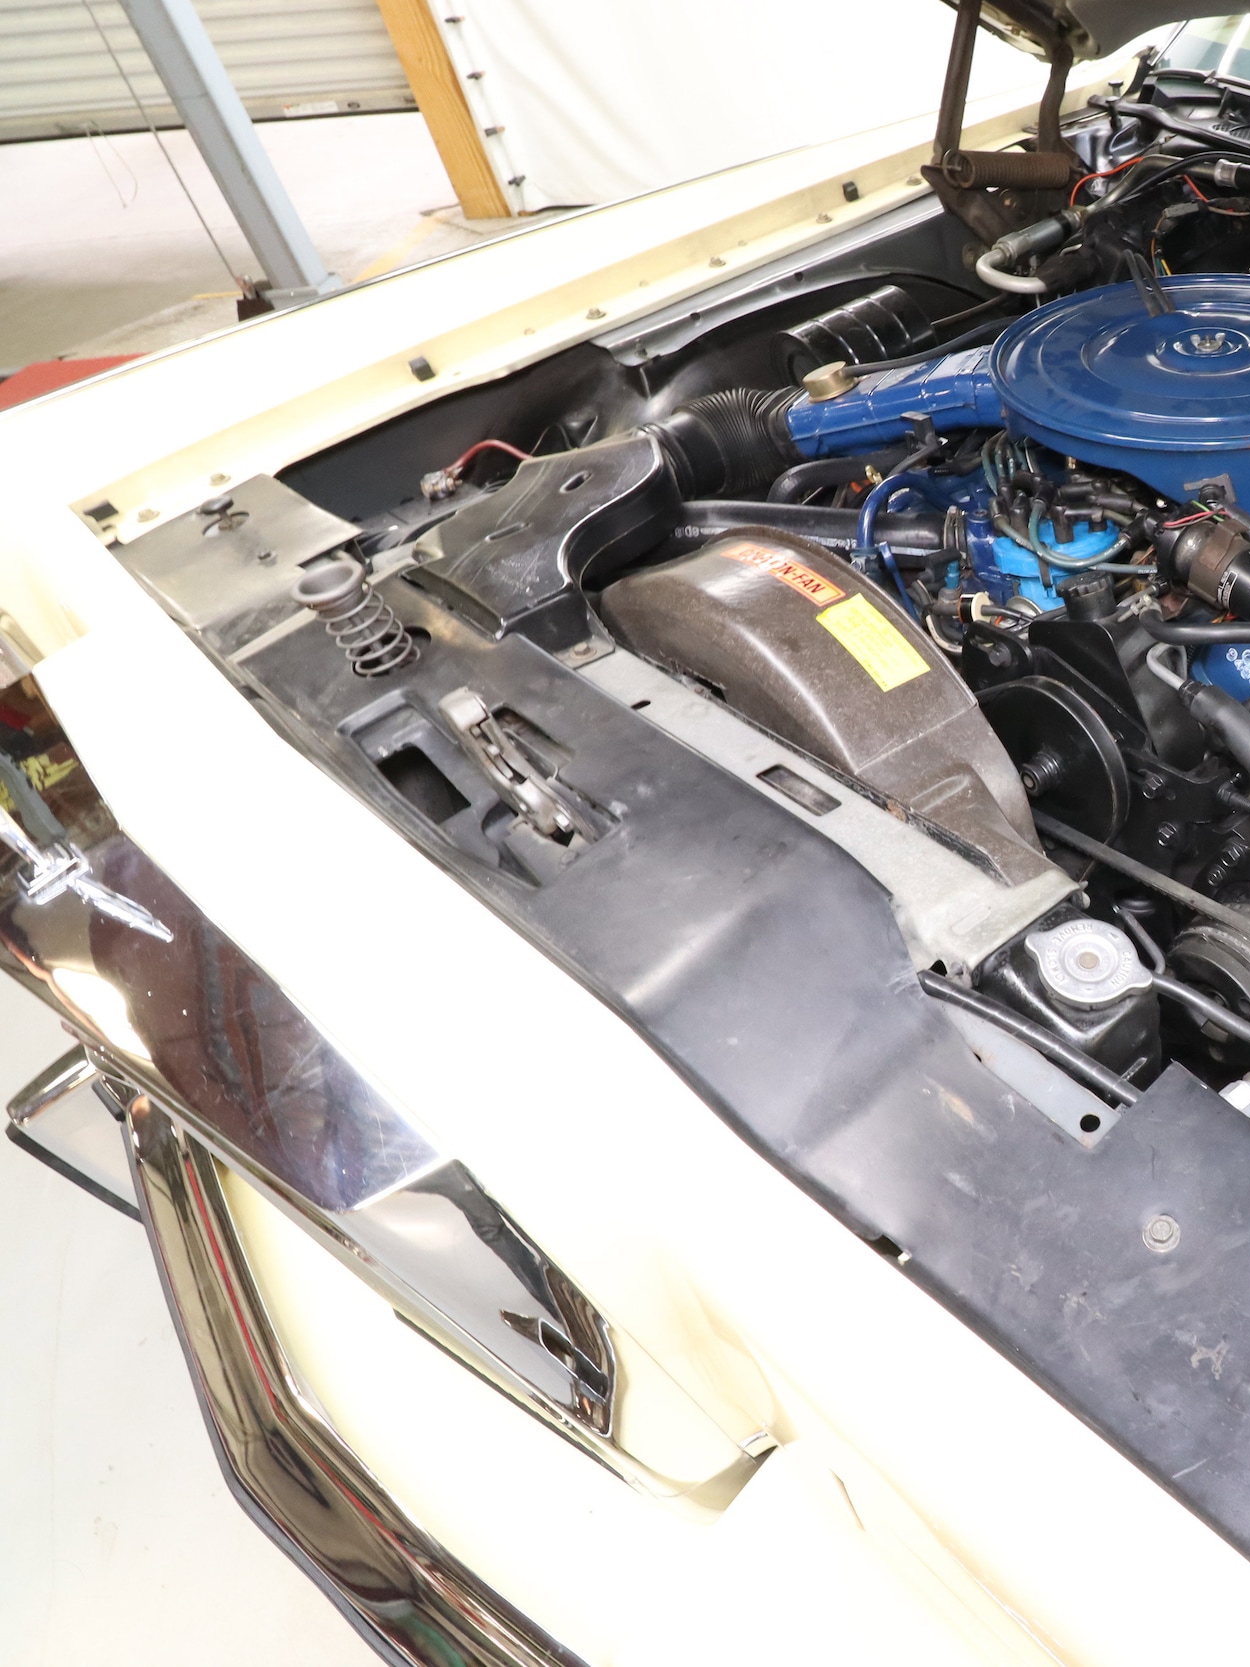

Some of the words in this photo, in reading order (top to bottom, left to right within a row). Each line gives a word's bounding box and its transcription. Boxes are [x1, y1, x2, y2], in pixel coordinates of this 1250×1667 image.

[1052, 923, 1093, 946] REMOVE
[1046, 948, 1069, 986] SLOWLY
[1111, 951, 1133, 990] CAUTION
